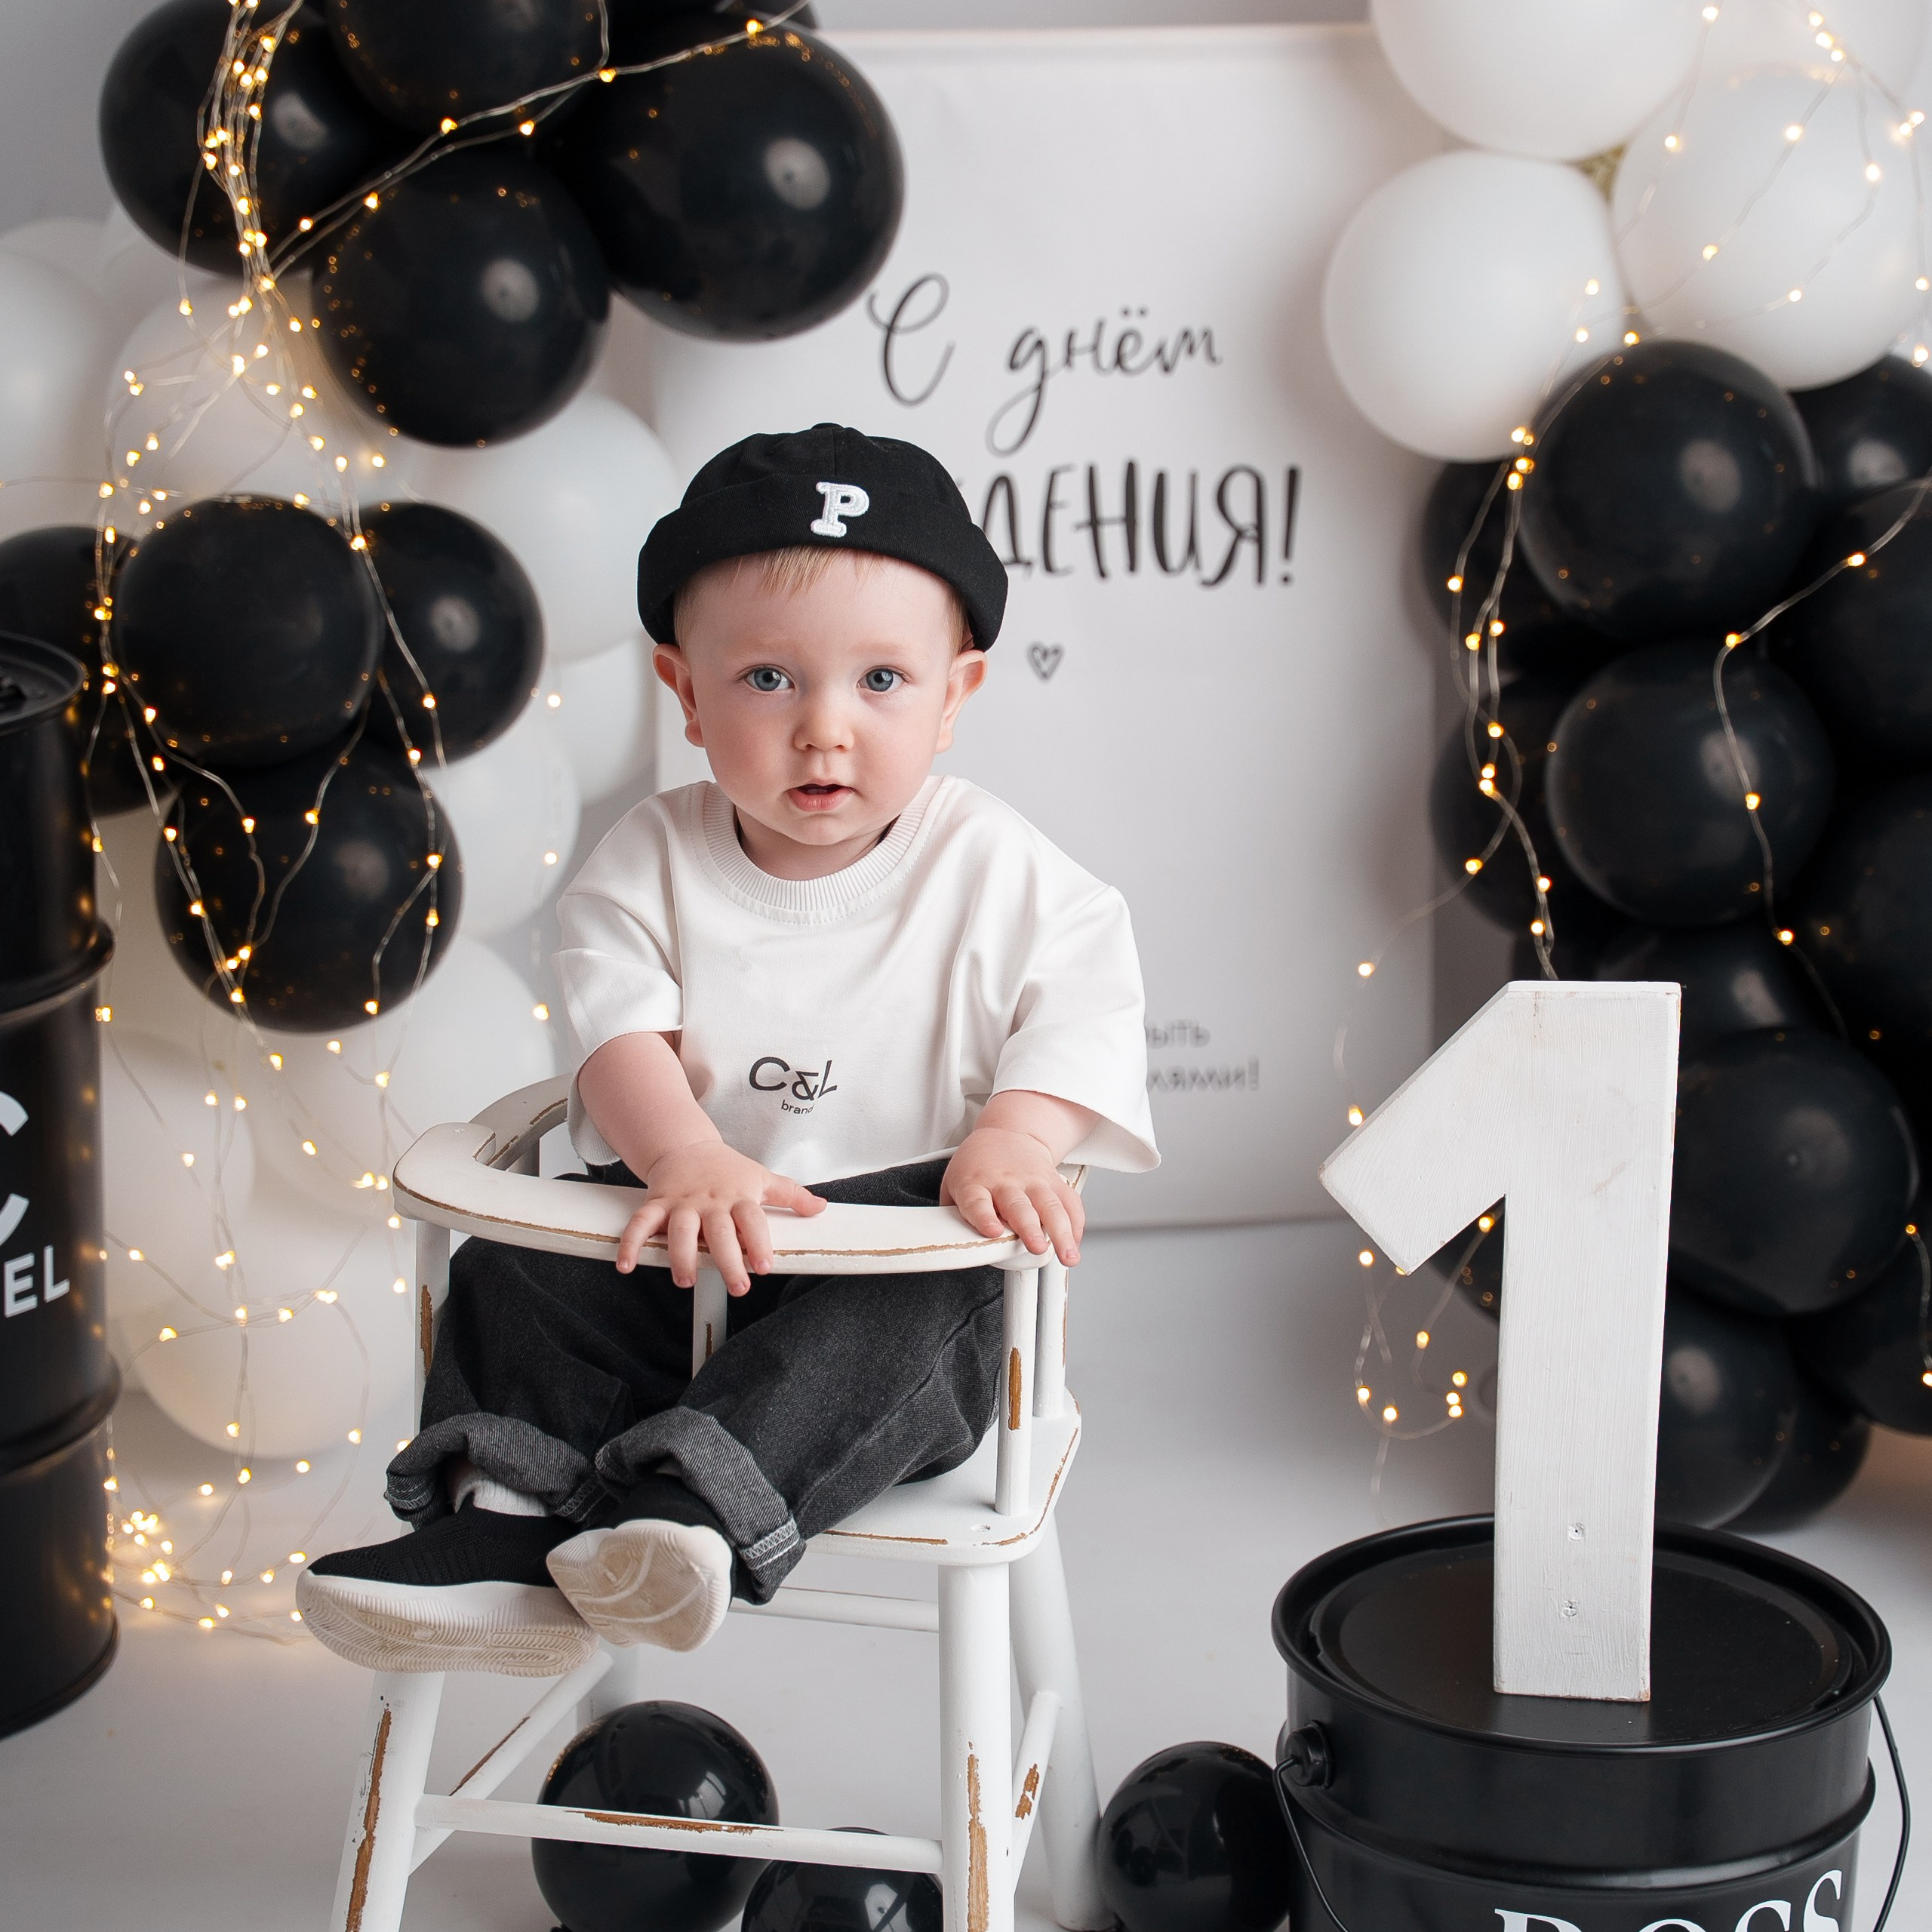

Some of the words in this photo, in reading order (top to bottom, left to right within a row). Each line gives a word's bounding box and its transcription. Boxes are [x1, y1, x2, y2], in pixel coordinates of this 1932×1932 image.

[866, 272, 955, 408] С
[985, 305, 1223, 457] днём
[810, 481, 870, 538] P
[978, 459, 1303, 588] ДЕНИЯ!
[749, 1056, 838, 1102] C&L
[780, 1099, 815, 1115] brand
[1320, 980, 1681, 1702] 1
